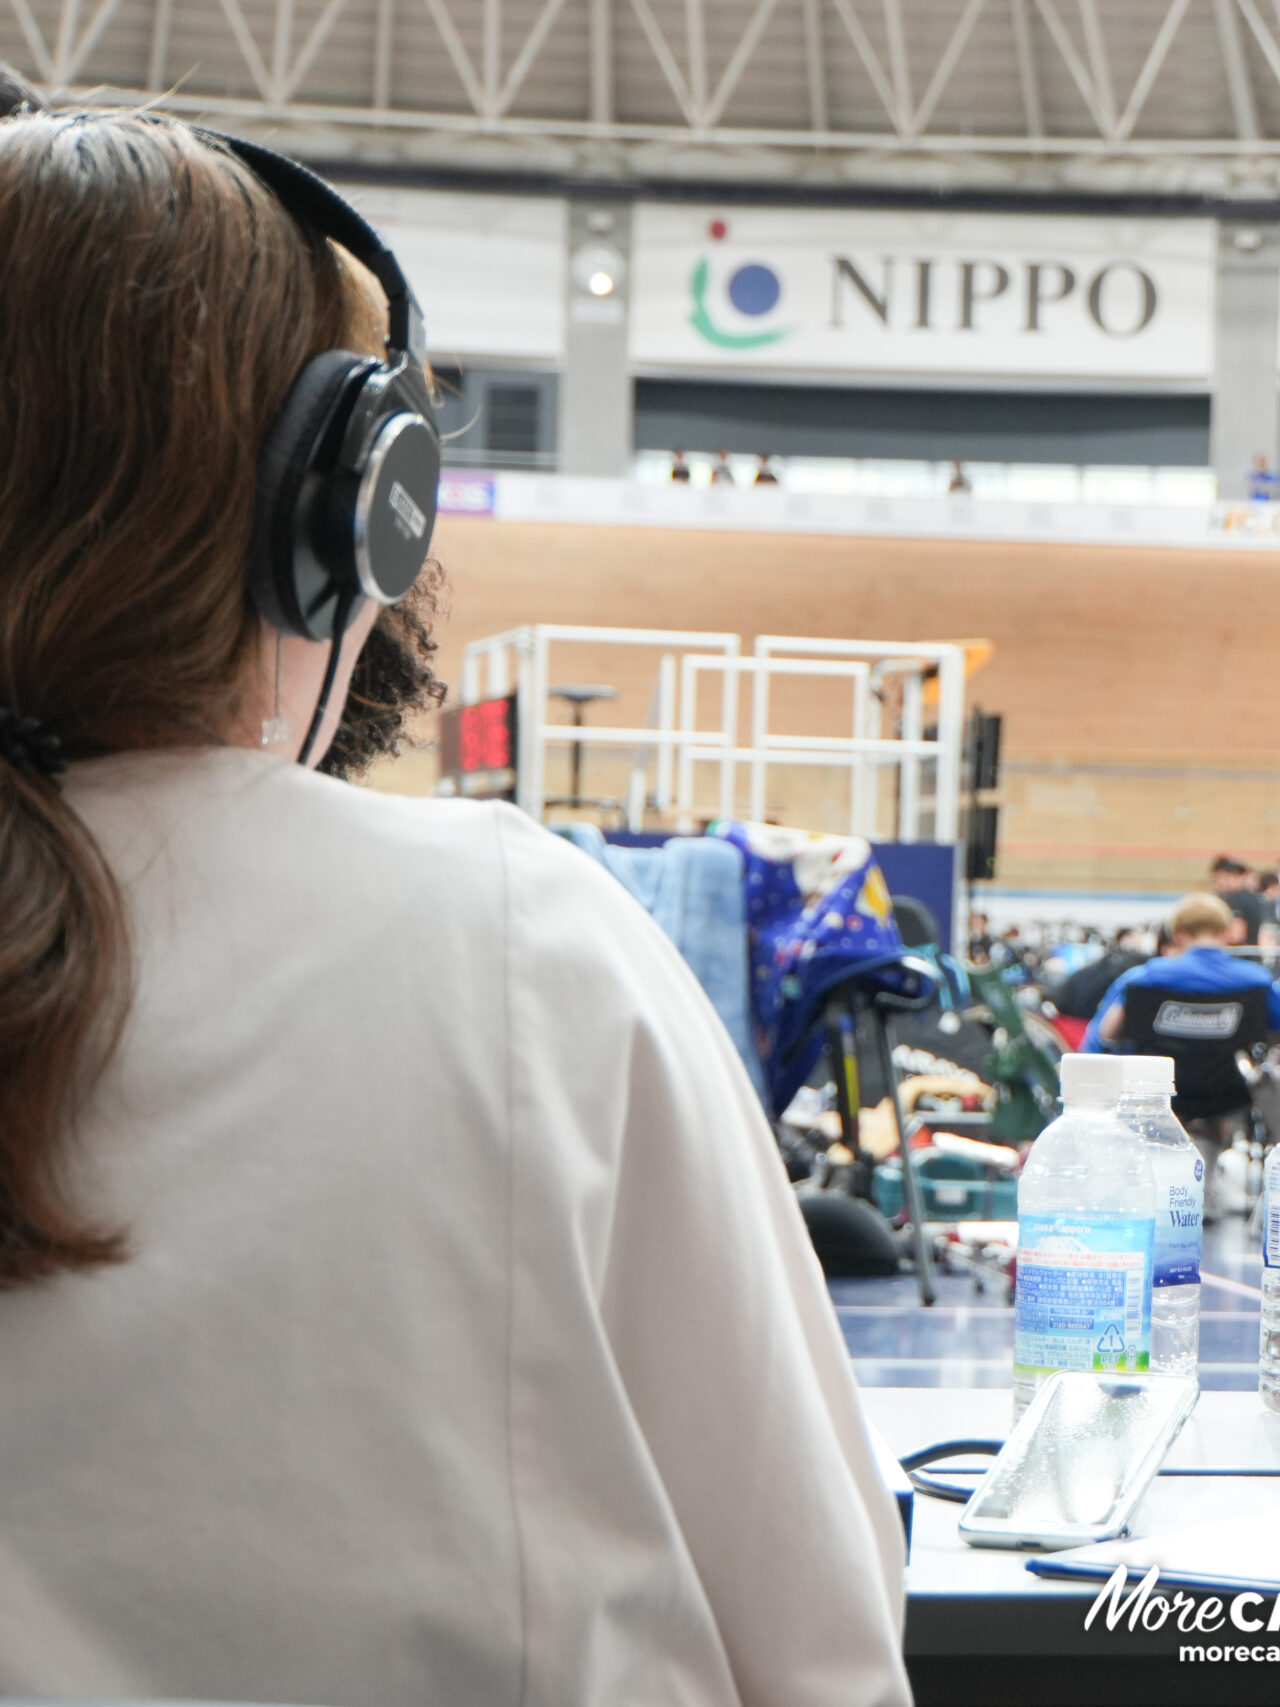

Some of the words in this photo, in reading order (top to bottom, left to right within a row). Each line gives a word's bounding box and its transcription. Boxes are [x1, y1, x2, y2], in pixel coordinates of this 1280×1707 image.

[829, 255, 1159, 340] NIPPO
[1169, 1186, 1188, 1197] Body
[1169, 1197, 1196, 1208] Friendly
[1170, 1210, 1200, 1228] Water
